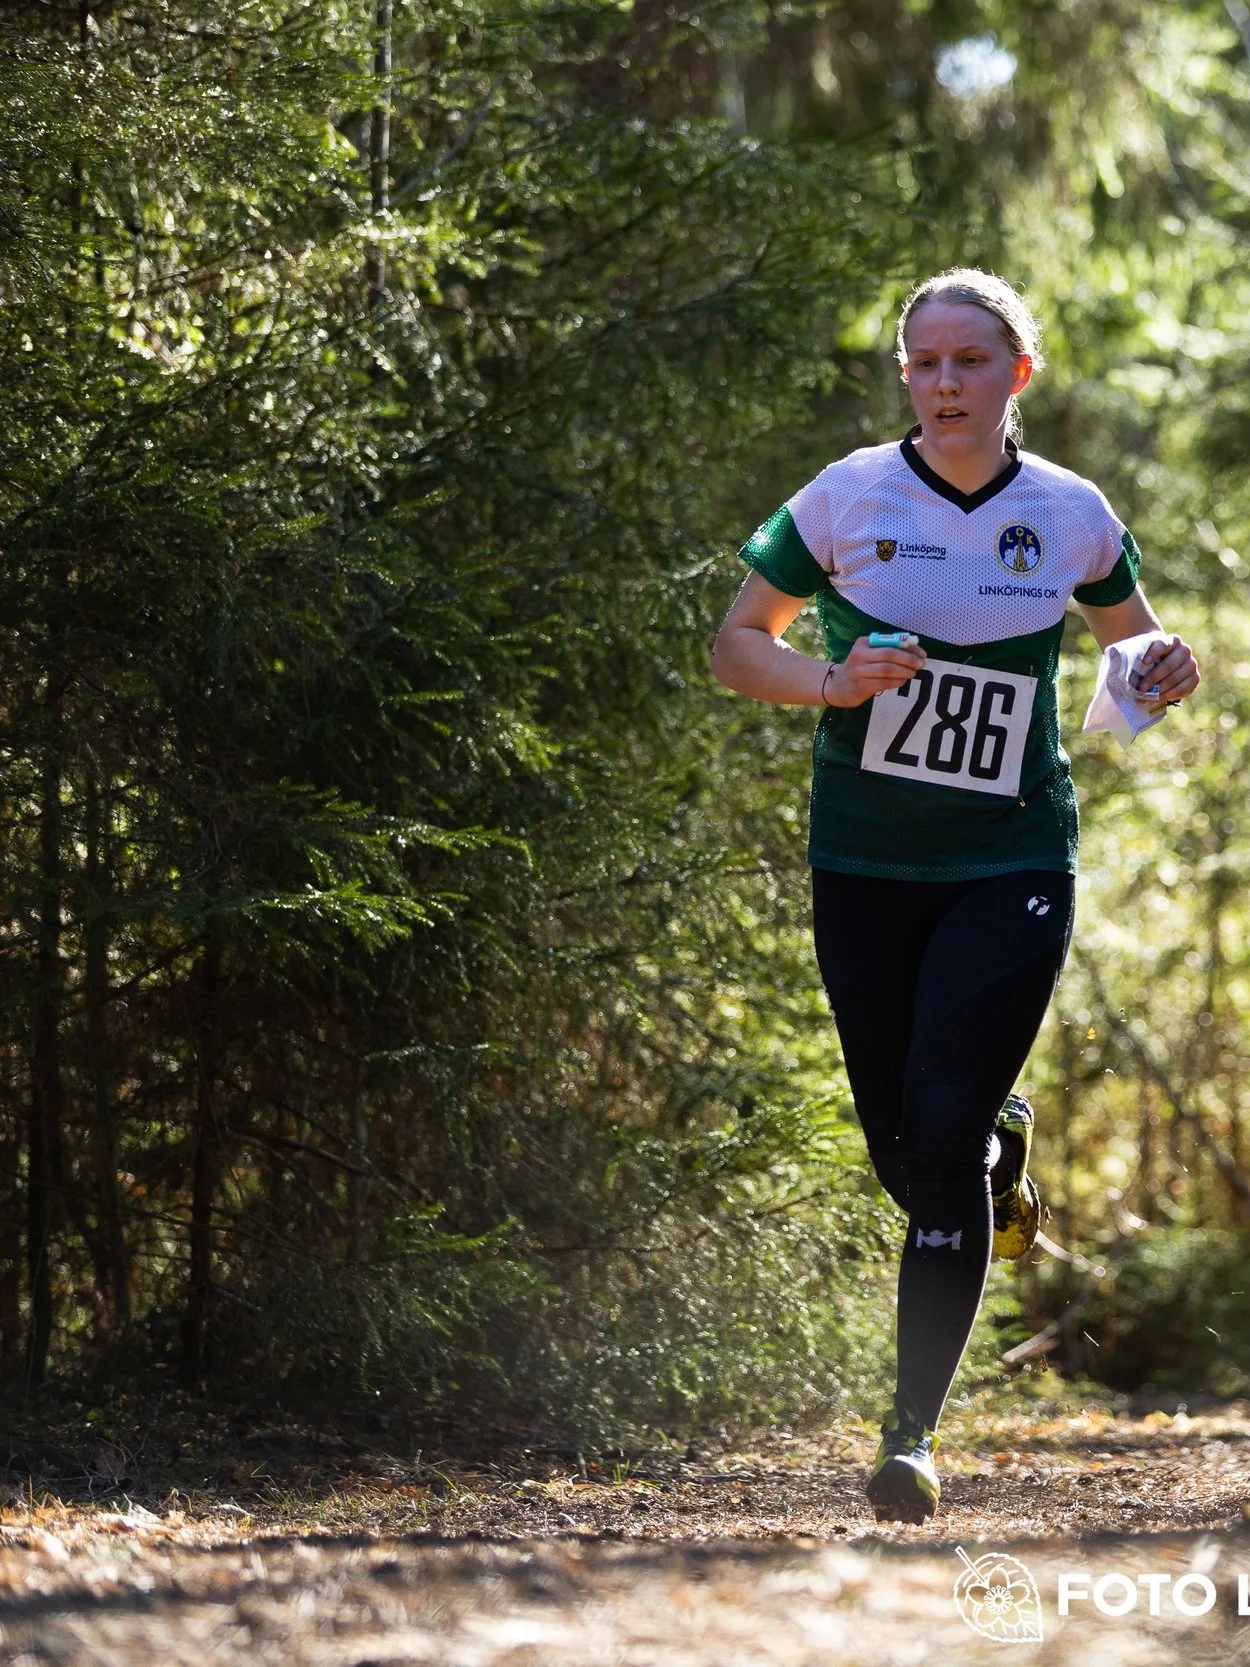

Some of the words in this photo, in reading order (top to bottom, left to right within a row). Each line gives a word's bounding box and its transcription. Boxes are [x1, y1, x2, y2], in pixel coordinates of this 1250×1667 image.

[900, 543, 946, 556] Linköping
[980, 584, 1042, 598] LINKÖPINGS
[1044, 589, 1059, 599] OK
[884, 668, 1016, 781] 286
